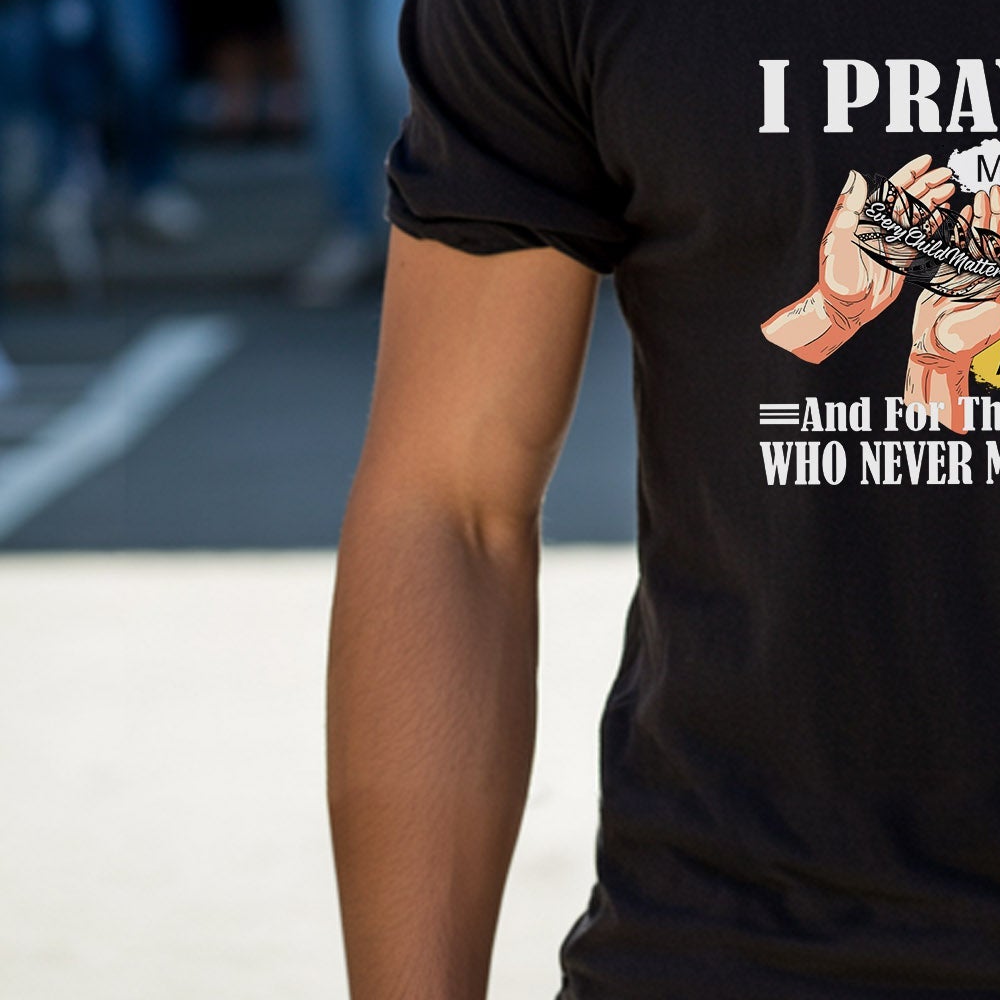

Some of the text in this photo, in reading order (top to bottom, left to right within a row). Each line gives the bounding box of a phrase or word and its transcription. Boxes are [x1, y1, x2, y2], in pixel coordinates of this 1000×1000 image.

[759, 59, 790, 133] I
[865, 202, 907, 242] Every
[904, 226, 946, 261] Child
[800, 396, 872, 432] And
[884, 396, 945, 432] For
[759, 441, 847, 486] WHO
[860, 440, 973, 485] NEVER
